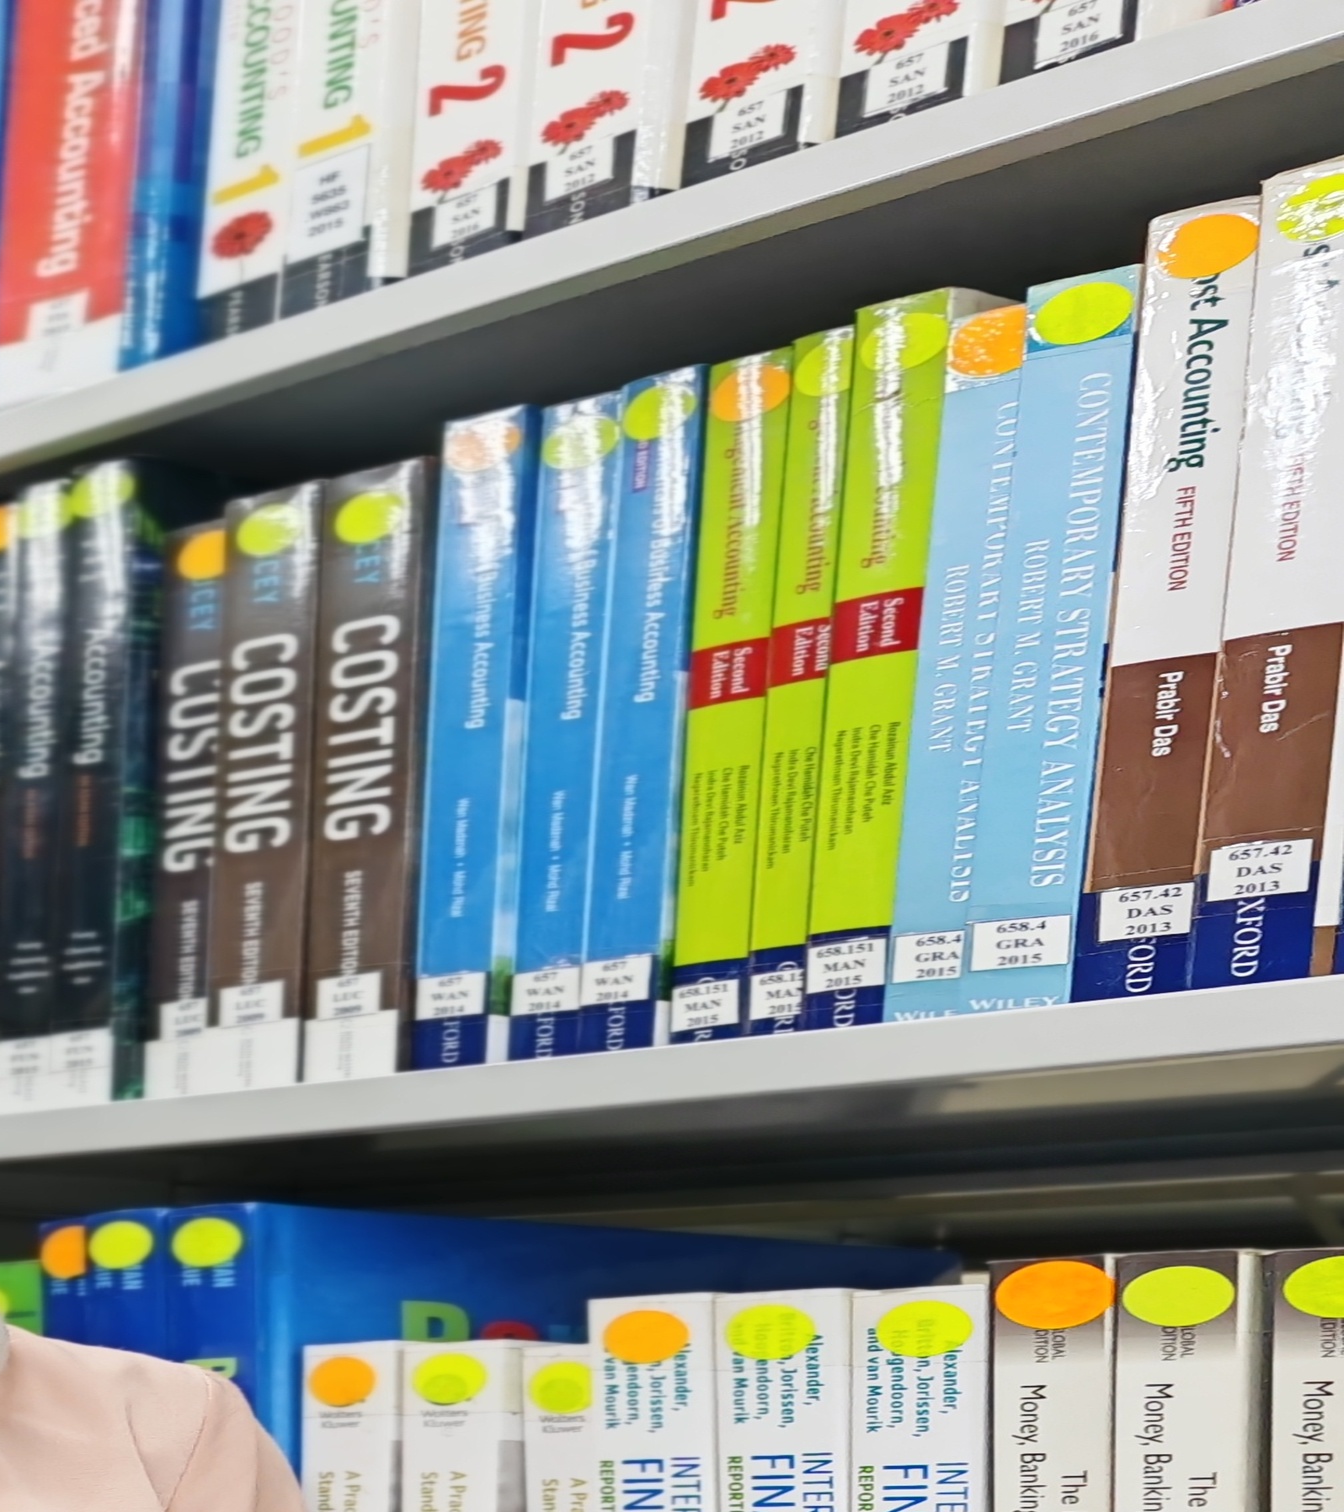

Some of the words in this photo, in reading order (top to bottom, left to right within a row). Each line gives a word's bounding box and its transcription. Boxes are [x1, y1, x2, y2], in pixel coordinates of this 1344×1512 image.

[550, 11, 634, 68] 2
[1060, 14, 1100, 35] SAN
[1060, 31, 1100, 52] 2016
[888, 67, 926, 87] SAN
[894, 52, 924, 71] 657
[427, 64, 505, 118] 2
[730, 130, 764, 149] 2012
[731, 114, 766, 134] SAN
[36, 72, 105, 278] Accounting
[564, 158, 597, 177] SAN
[1163, 317, 1230, 473] Accounting
[1059, 372, 1112, 599] CONTEMPORARY
[1275, 501, 1302, 563] EDITION
[1166, 530, 1193, 592] EDITION
[570, 556, 598, 629] Business
[1016, 538, 1051, 625] ROBERT
[856, 600, 880, 652] Edition
[879, 597, 905, 648] Second
[633, 611, 667, 703] Accounting
[791, 625, 814, 677] Edition
[1261, 643, 1293, 696] Prabir
[464, 641, 494, 730] Accounting
[560, 631, 593, 721] Accounting
[709, 650, 730, 699] Edition
[1043, 607, 1092, 750] STRATEGY
[72, 628, 112, 766] Accounting
[1006, 661, 1041, 735] GRANT
[323, 614, 402, 842] COSTING
[1257, 698, 1288, 735] Das
[223, 632, 300, 855] COSTING
[1150, 723, 1181, 758] Das
[1029, 760, 1077, 889] ANALYSIS
[1227, 843, 1293, 863] 657.42
[1234, 861, 1284, 879] DAS
[242, 881, 263, 937] SEVENTH
[342, 869, 363, 928] SEVENTH
[1118, 886, 1183, 904] 657.42
[1124, 904, 1174, 921] DAS
[914, 933, 963, 949] 658.4
[995, 920, 1047, 935] 658.4
[995, 936, 1045, 951] GRA
[1124, 921, 1173, 937] 2013
[815, 942, 875, 960] 658.151
[822, 958, 867, 975] MAN
[914, 949, 961, 965] GRA
[996, 952, 1043, 967] 2015
[524, 984, 566, 998] WAN
[824, 974, 864, 989] 2015
[915, 965, 958, 980] 2015
[430, 989, 471, 1002] WAN
[528, 999, 562, 1013] 2014
[1011, 1383, 1048, 1446] Money,
[1292, 1379, 1335, 1446] Money,
[1059, 1470, 1089, 1507] The
[1187, 1471, 1218, 1509] The
